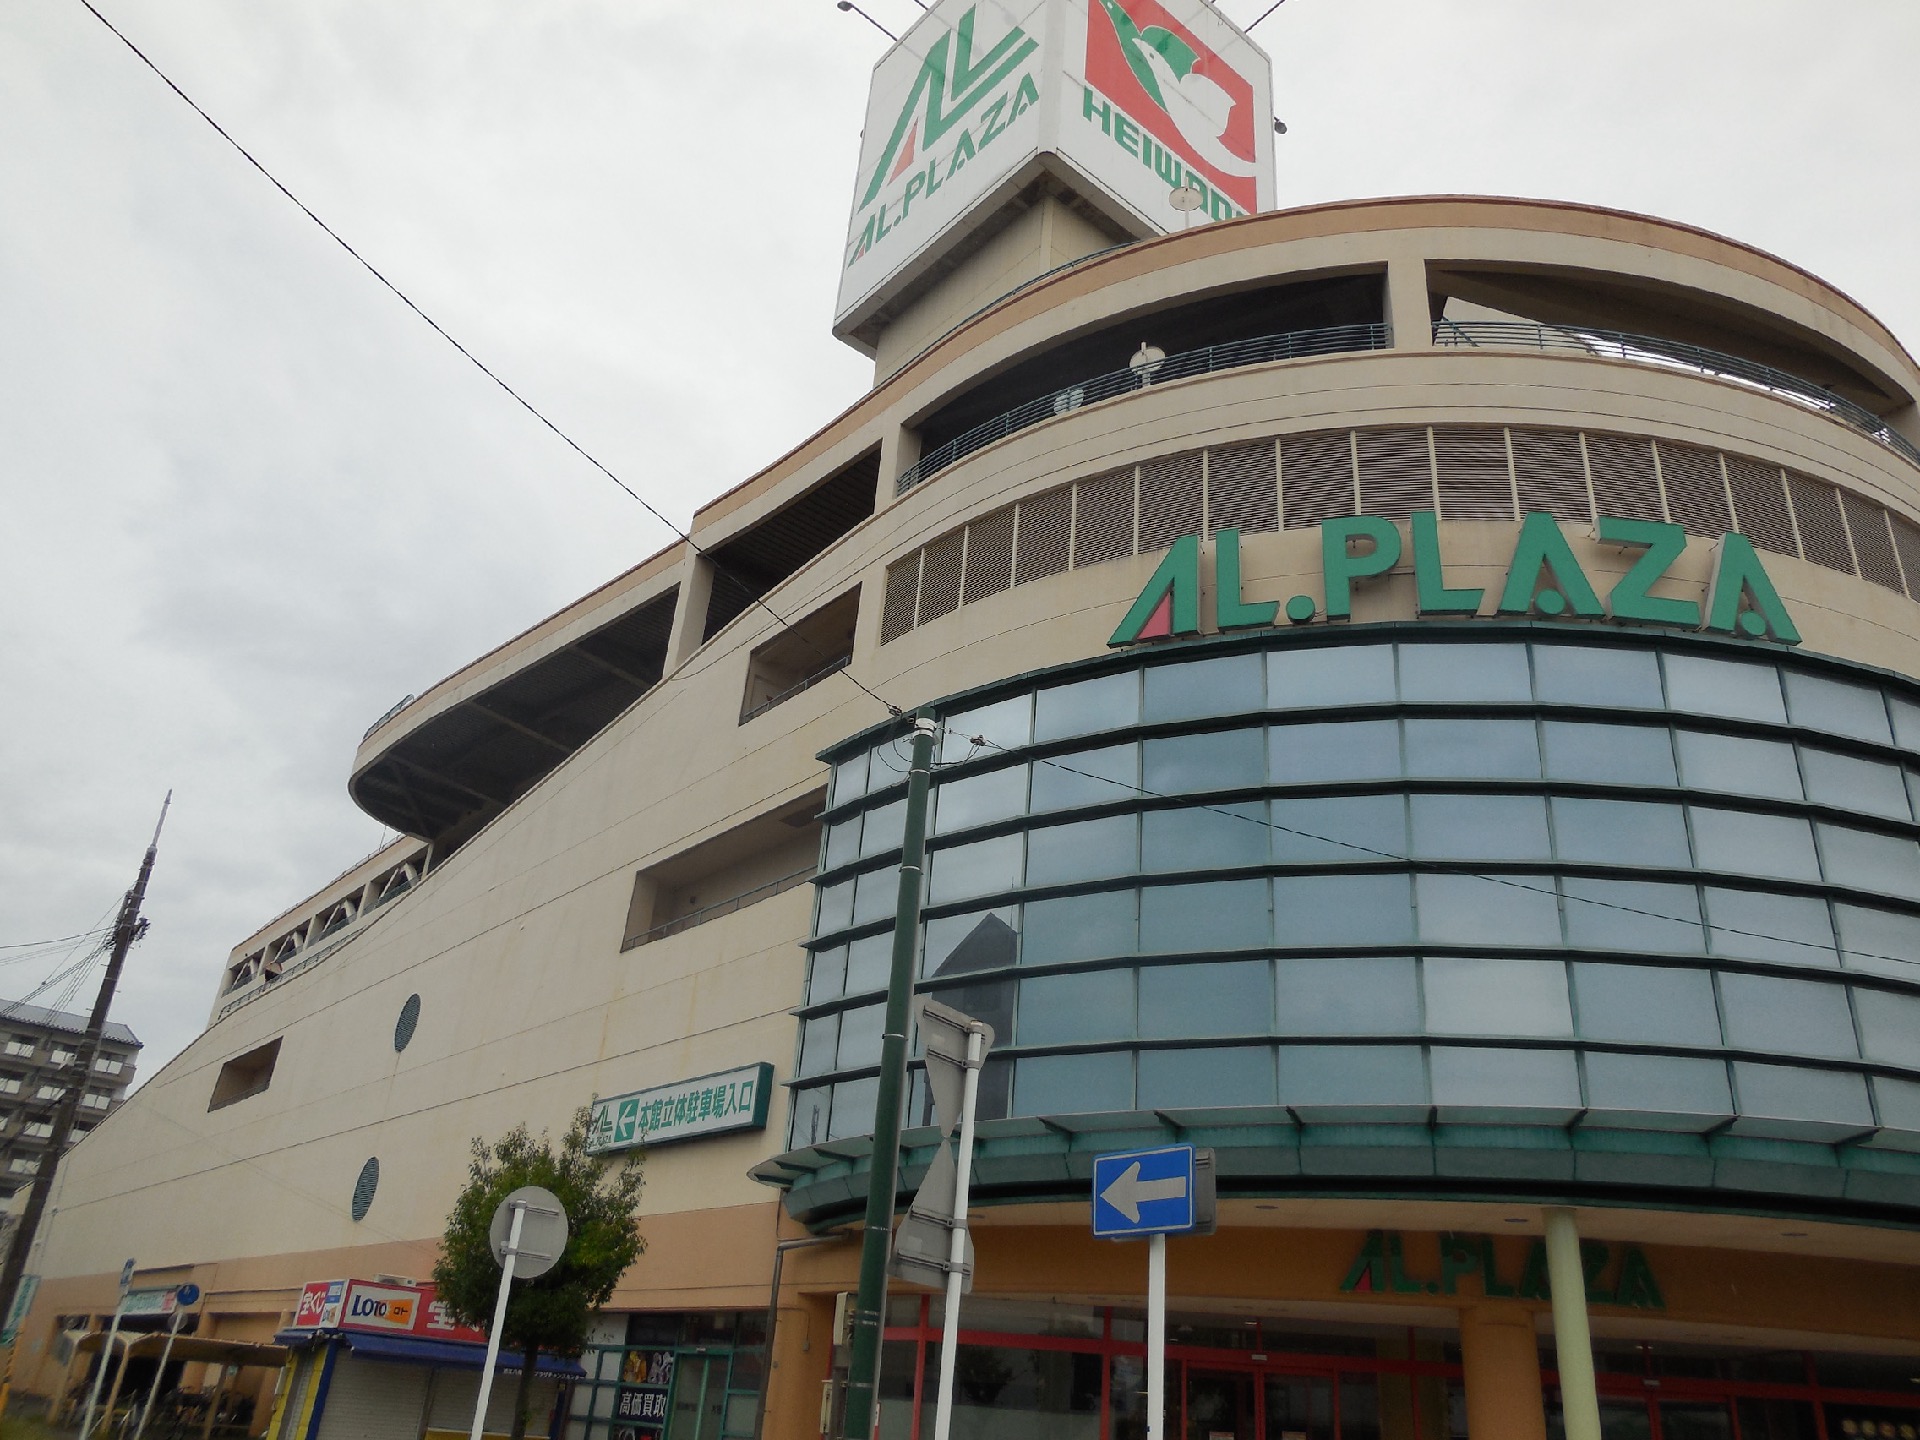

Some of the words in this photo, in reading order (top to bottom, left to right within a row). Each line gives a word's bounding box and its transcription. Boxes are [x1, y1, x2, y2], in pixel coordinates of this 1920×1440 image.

[1106, 511, 1803, 648] AL.PLAZA
[638, 1080, 754, 1131] 本館立体駐車場入口
[300, 1290, 327, 1316] 宝くじ
[352, 1294, 387, 1317] LOTO
[619, 1391, 667, 1418] 高価買取
